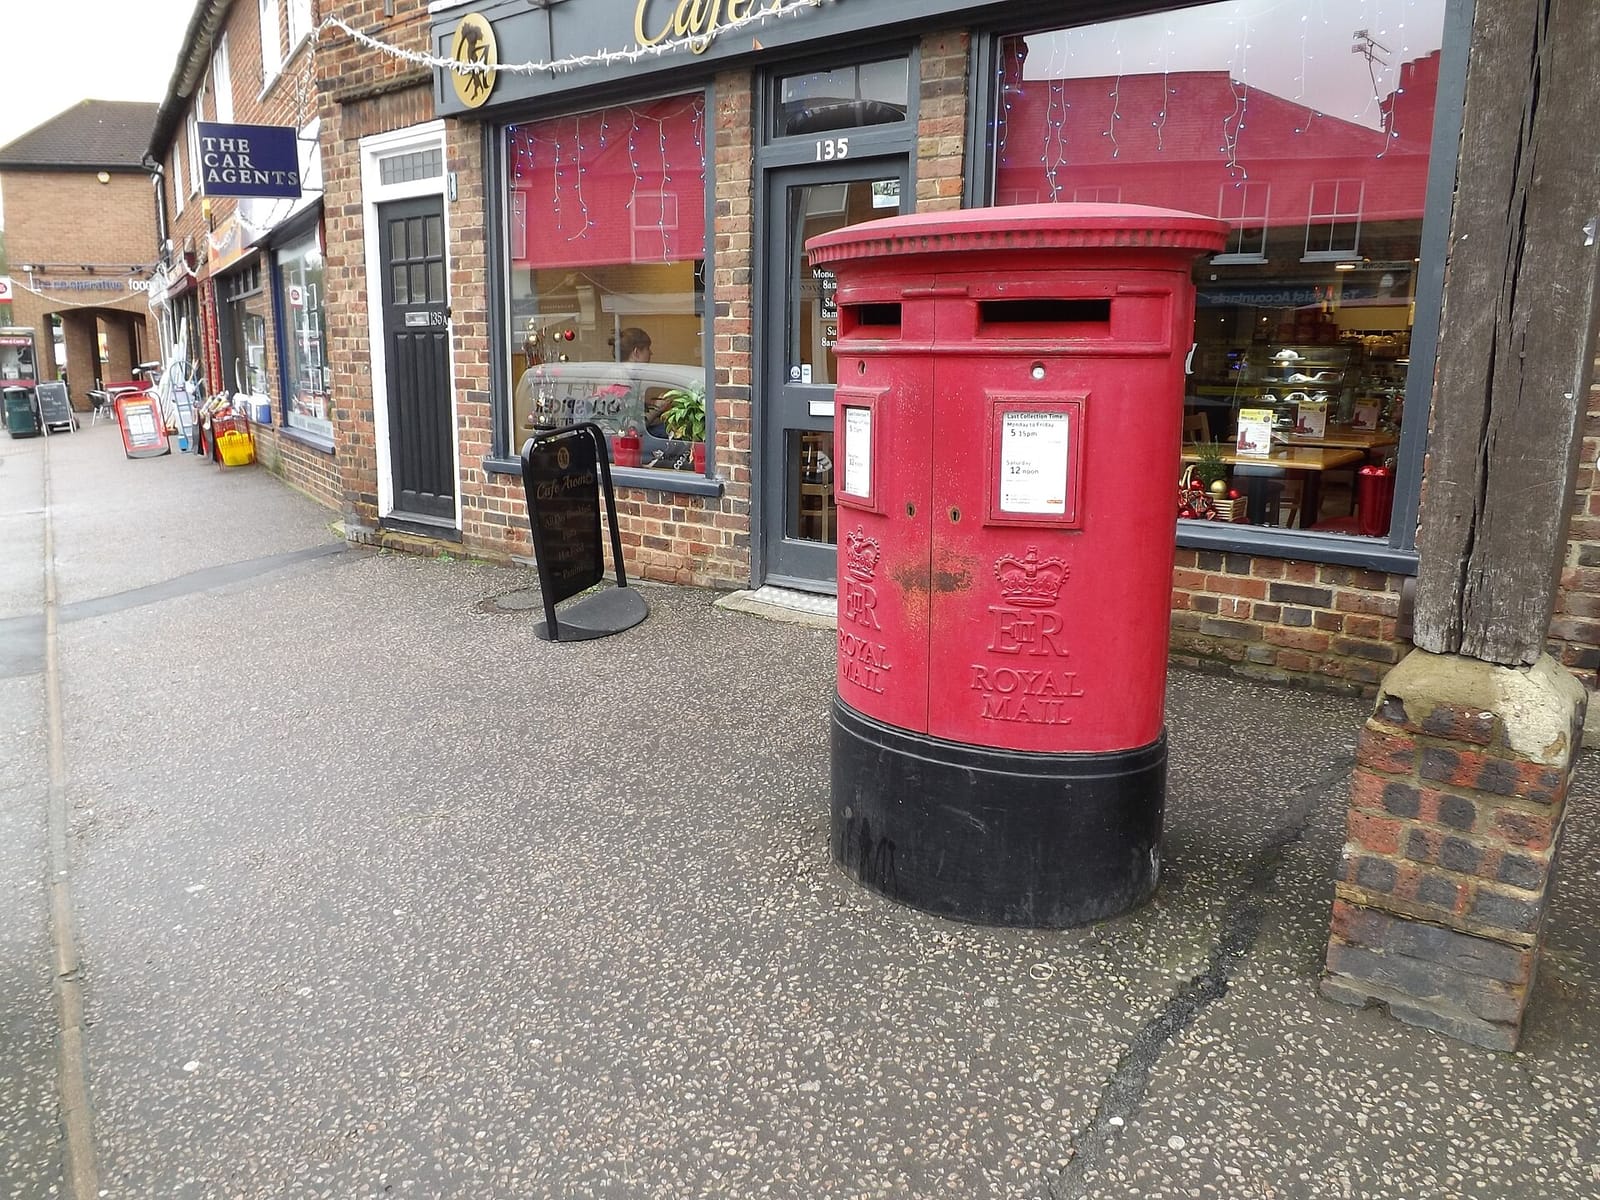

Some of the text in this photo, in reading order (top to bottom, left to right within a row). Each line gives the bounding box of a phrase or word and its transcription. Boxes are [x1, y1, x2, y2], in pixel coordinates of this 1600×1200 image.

[202, 137, 250, 152] THE
[816, 138, 849, 161] 135
[204, 153, 255, 168] CAR
[207, 169, 298, 185] AGENTS
[1010, 466, 1021, 475] 12
[839, 628, 892, 671] ROYAL
[842, 654, 885, 695] MAIL
[970, 664, 1085, 697] ROYAL
[981, 693, 1072, 725] MAIL
